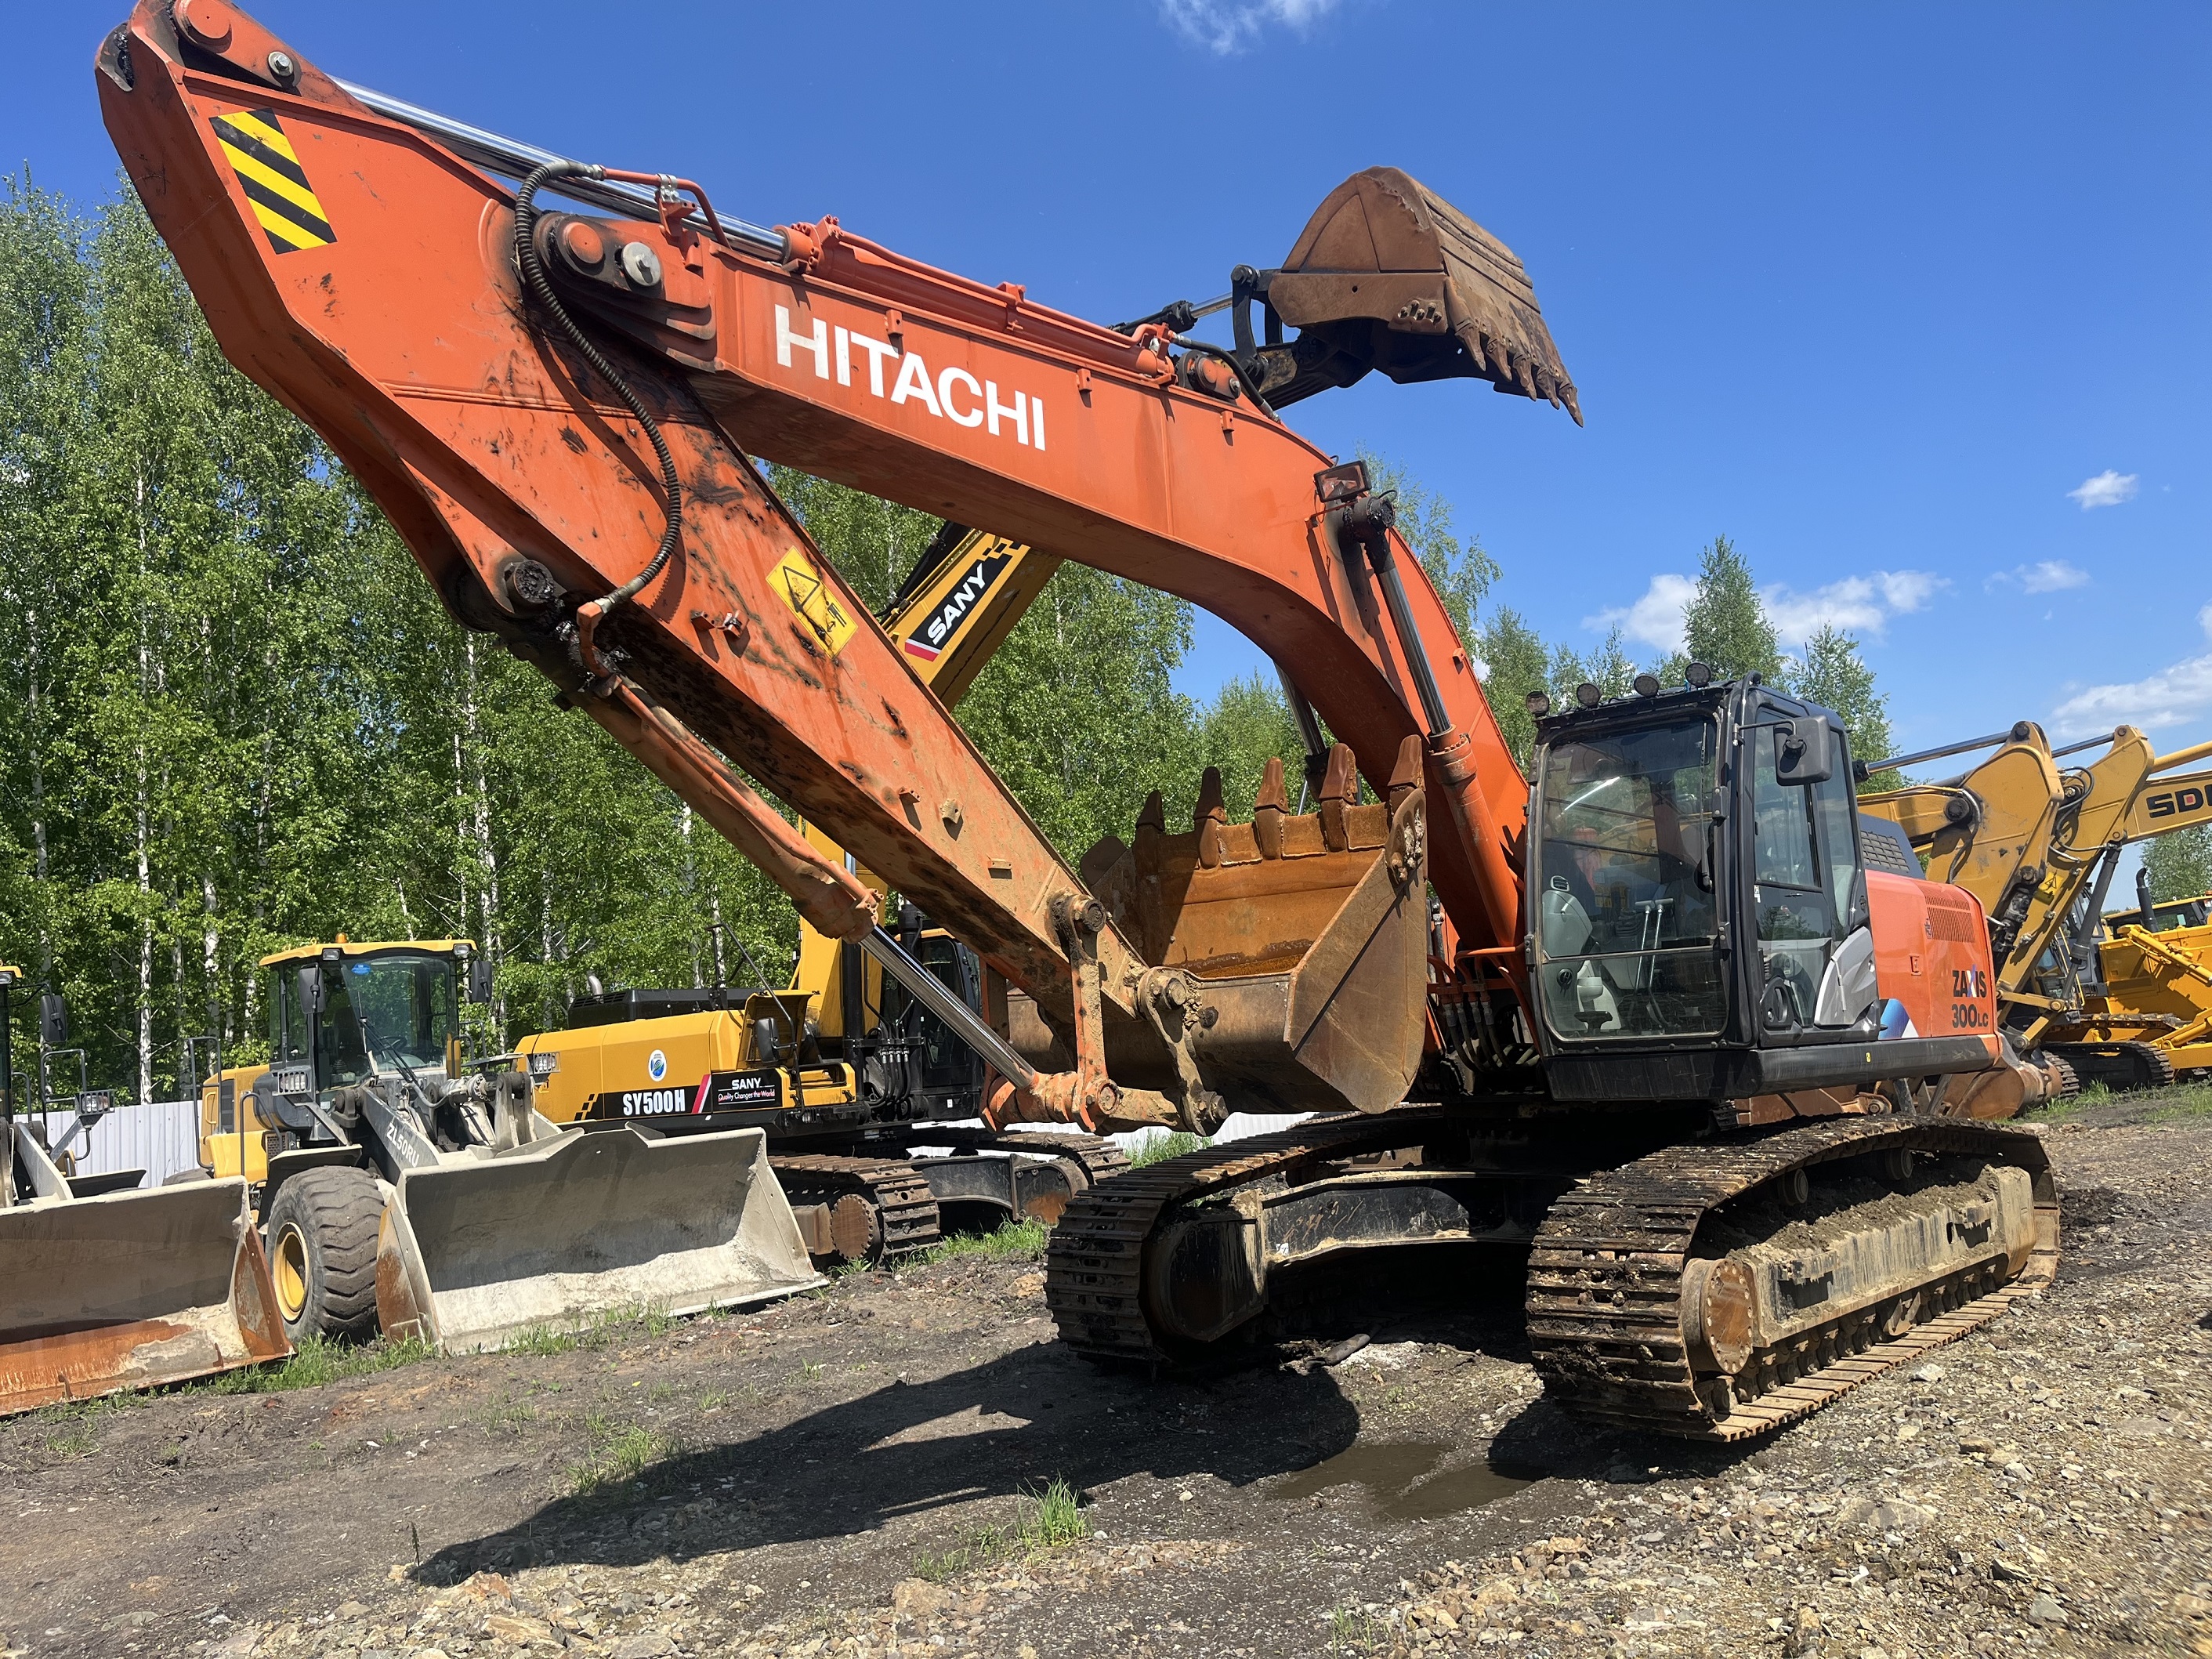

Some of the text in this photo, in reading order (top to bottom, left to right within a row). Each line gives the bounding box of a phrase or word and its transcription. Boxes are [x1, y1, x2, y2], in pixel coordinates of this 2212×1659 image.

[774, 303, 1046, 451] HITACHI
[927, 563, 987, 646] SANY
[1952, 964, 1987, 998] ZAXIS
[1951, 1003, 1989, 1029] 300LC
[718, 1092, 734, 1102] Quality
[734, 1091, 753, 1100] Changes
[761, 1088, 776, 1097] World
[731, 1077, 762, 1090] SANY
[622, 1088, 686, 1116] SY500H
[386, 1122, 420, 1168] ZL50RU
